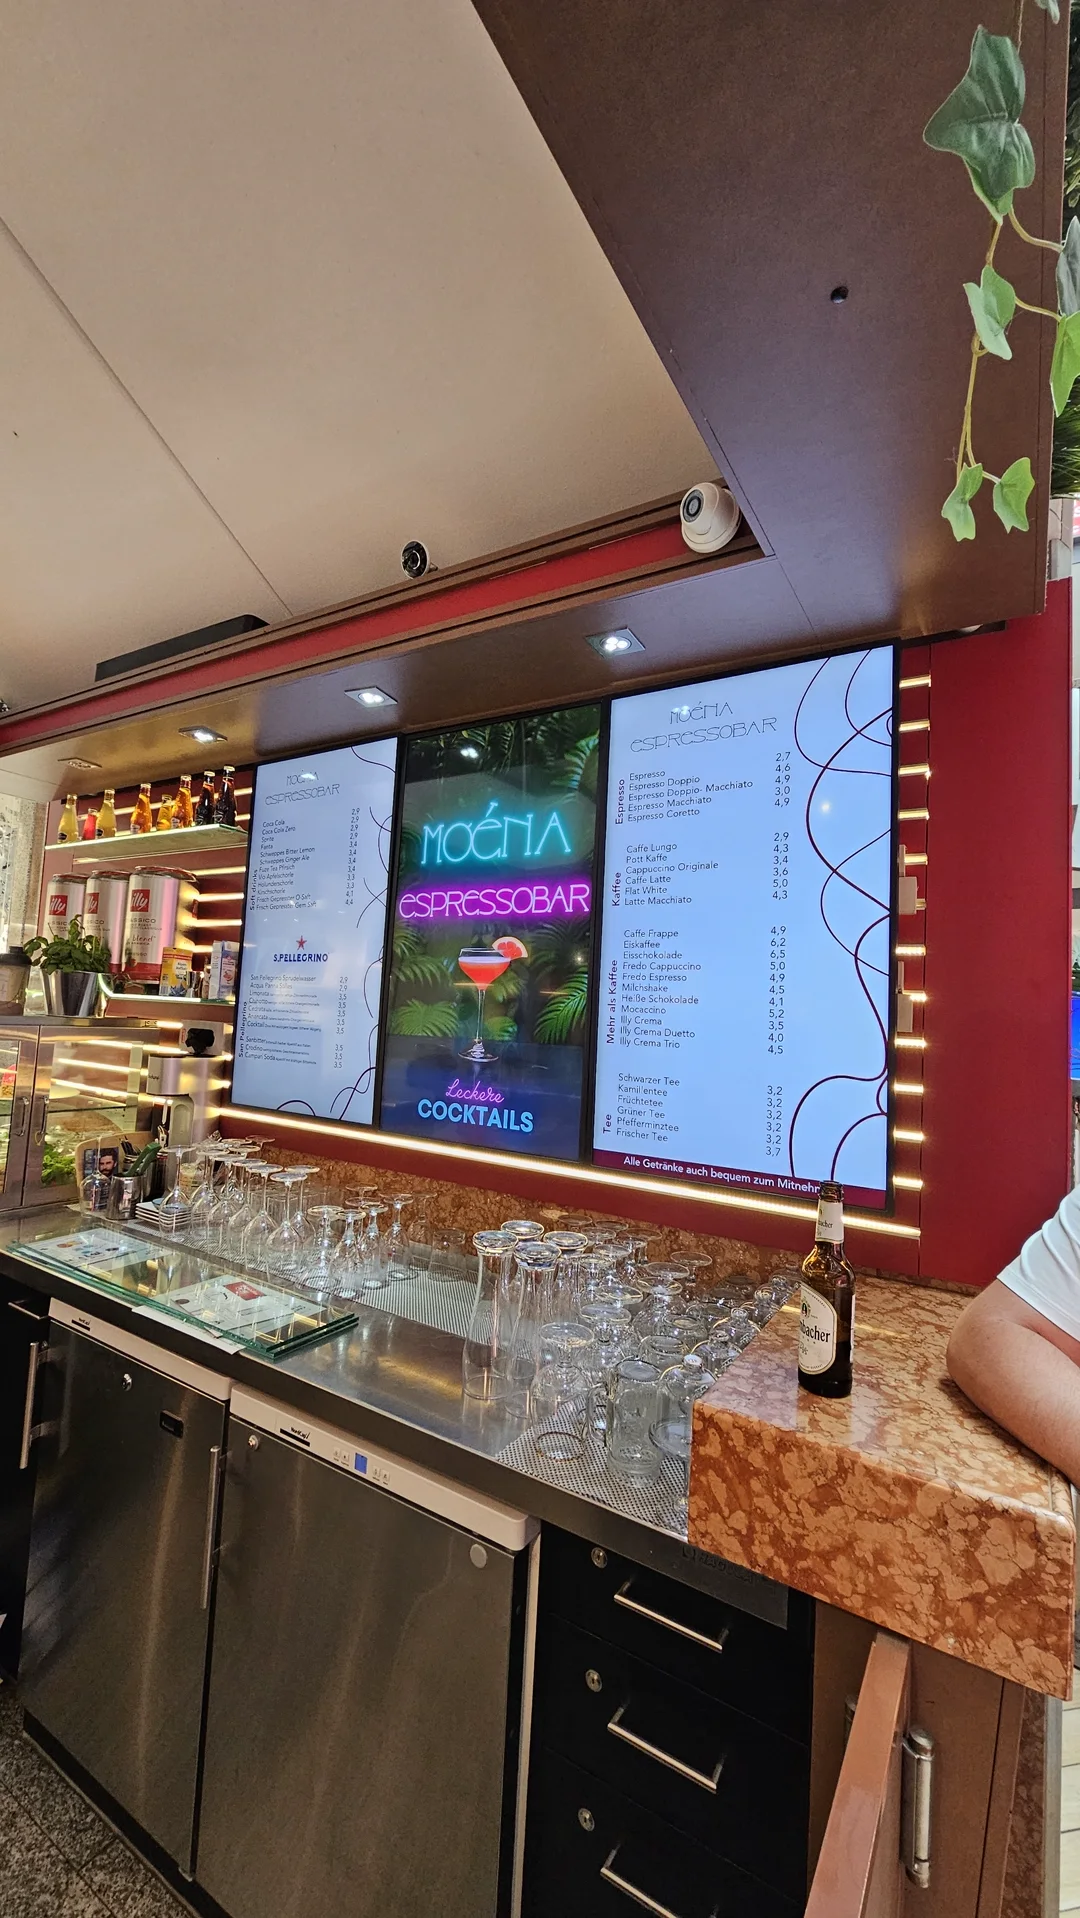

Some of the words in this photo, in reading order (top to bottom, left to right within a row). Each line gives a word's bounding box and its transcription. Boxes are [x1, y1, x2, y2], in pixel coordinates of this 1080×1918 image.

[776, 752, 790, 762] 2,7
[776, 763, 790, 773] 4,6
[630, 771, 665, 781] Espresso
[775, 774, 790, 784] 4,9
[630, 782, 664, 792] Espresso
[668, 777, 700, 786] Doppio
[629, 792, 664, 802] Espresso
[706, 781, 753, 792] Macchiato
[775, 786, 790, 796] 3,0
[615, 779, 626, 824] Espresso
[628, 803, 664, 812] Espresso
[667, 797, 712, 807] Macchiato
[774, 797, 790, 808] 4,9
[628, 813, 664, 823] Espresso
[667, 809, 700, 817] Coretto
[774, 832, 789, 842] 2,9
[627, 844, 648, 853] Caffe
[651, 843, 677, 852] Lungo
[774, 844, 788, 854] 4,3
[646, 853, 667, 862] Kaffe
[773, 855, 788, 865] 3,4
[626, 865, 675, 875] Cappuccino
[678, 860, 718, 872] Originale
[773, 867, 788, 877] 3,6
[626, 876, 646, 884] Caffe
[650, 875, 671, 883] Latte
[773, 879, 788, 888] 5,0
[612, 872, 621, 906] Kaffee
[625, 887, 640, 895] Flat
[642, 886, 667, 894] White
[648, 895, 692, 904] Macchiato
[772, 890, 787, 900] 4,3
[50, 898, 66, 914] illy
[132, 893, 148, 910] illy
[624, 929, 645, 937] Caffe
[649, 929, 679, 939] Frappe
[771, 926, 786, 936] 4,9
[624, 940, 660, 948] Eiskaffee
[771, 938, 786, 948] 6,2
[273, 953, 328, 962] S.PELLEGRINO
[623, 950, 682, 959] Eisschokolade
[770, 950, 785, 959] 6,5
[623, 961, 647, 969] Fredo
[650, 962, 701, 972] Cappuccino
[770, 961, 785, 971] 5,0
[609, 960, 618, 994] Kaffee
[623, 972, 646, 980] Fredo
[649, 973, 687, 983] Espresso
[770, 973, 785, 983] 4,9
[622, 983, 668, 992] Milchshake
[769, 985, 785, 995] 4,5
[622, 994, 646, 1002] Heiße
[649, 995, 699, 1004] Schokolade
[769, 997, 783, 1007] 4,1
[608, 998, 616, 1013] als
[621, 1005, 666, 1014] Mocaccino
[769, 1009, 784, 1019] 5,2
[621, 1015, 632, 1026] Illy
[635, 1016, 662, 1025] Crema
[606, 1016, 615, 1044] Mehr
[769, 1021, 784, 1031] 3,5
[620, 1026, 631, 1036] Illy
[634, 1027, 661, 1036] Crema
[664, 1028, 695, 1038] Duetto
[620, 1036, 631, 1047] Illy
[634, 1038, 661, 1047] Crema
[664, 1039, 680, 1048] Trio
[768, 1033, 784, 1043] 4,0
[768, 1045, 783, 1055] 4,5
[619, 1073, 661, 1084] Schwarzer
[664, 1077, 680, 1086] Tee
[445, 1078, 504, 1103] Leckere
[618, 1084, 667, 1096] Kamillentee
[767, 1085, 782, 1096] 3,2
[618, 1095, 663, 1107] Früchtetee
[767, 1097, 782, 1108] 3,2
[418, 1098, 534, 1133] COCKTAILS
[617, 1105, 646, 1116] Grüner
[649, 1109, 665, 1118] Tee
[767, 1110, 782, 1120] 3,2
[603, 1114, 612, 1133] Tee
[617, 1117, 679, 1131] Pfefferminztee
[766, 1122, 781, 1132] 3,2
[617, 1128, 649, 1139] Frischer
[652, 1132, 668, 1141] Tee
[766, 1134, 781, 1145] 3,2
[766, 1146, 780, 1157] 3,7
[624, 1157, 640, 1166] Alle
[643, 1159, 683, 1172] Getränke
[686, 1167, 707, 1176] auch
[711, 1168, 750, 1183] bequem
[754, 1177, 774, 1186] zum
